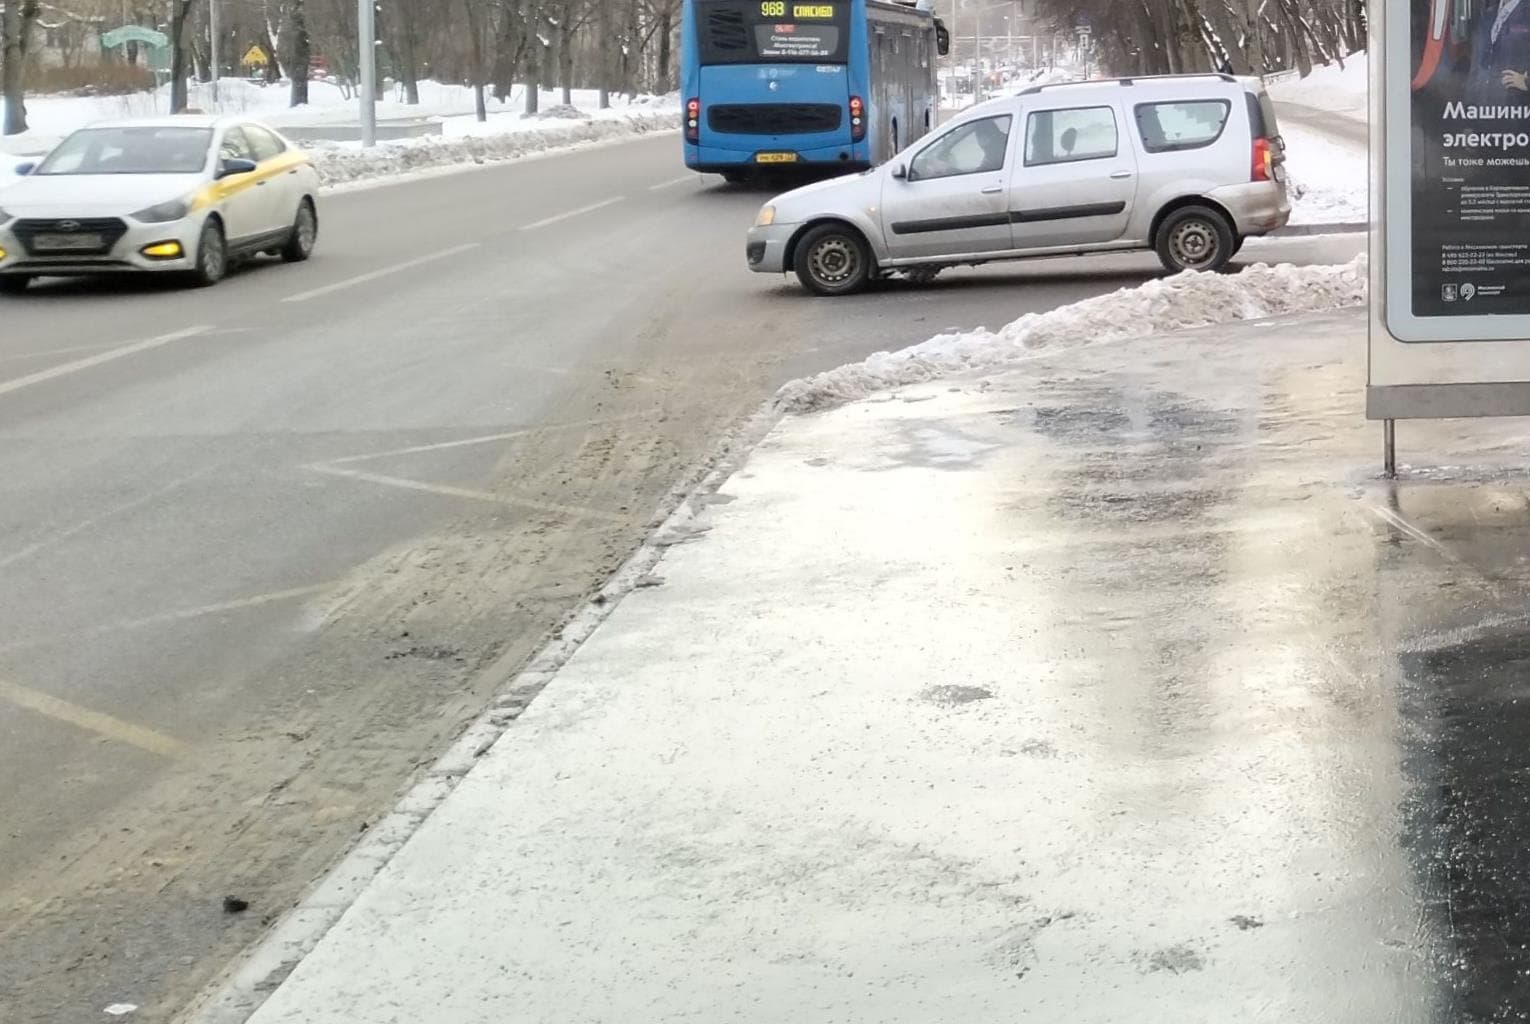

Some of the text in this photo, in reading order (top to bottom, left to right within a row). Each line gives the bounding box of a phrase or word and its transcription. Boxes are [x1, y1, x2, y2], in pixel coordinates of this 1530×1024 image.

[761, 1, 833, 17] 968 СПАСИБО
[1442, 156, 1456, 167] Ты
[1458, 157, 1484, 167] тоже
[1486, 157, 1529, 167] можешь
